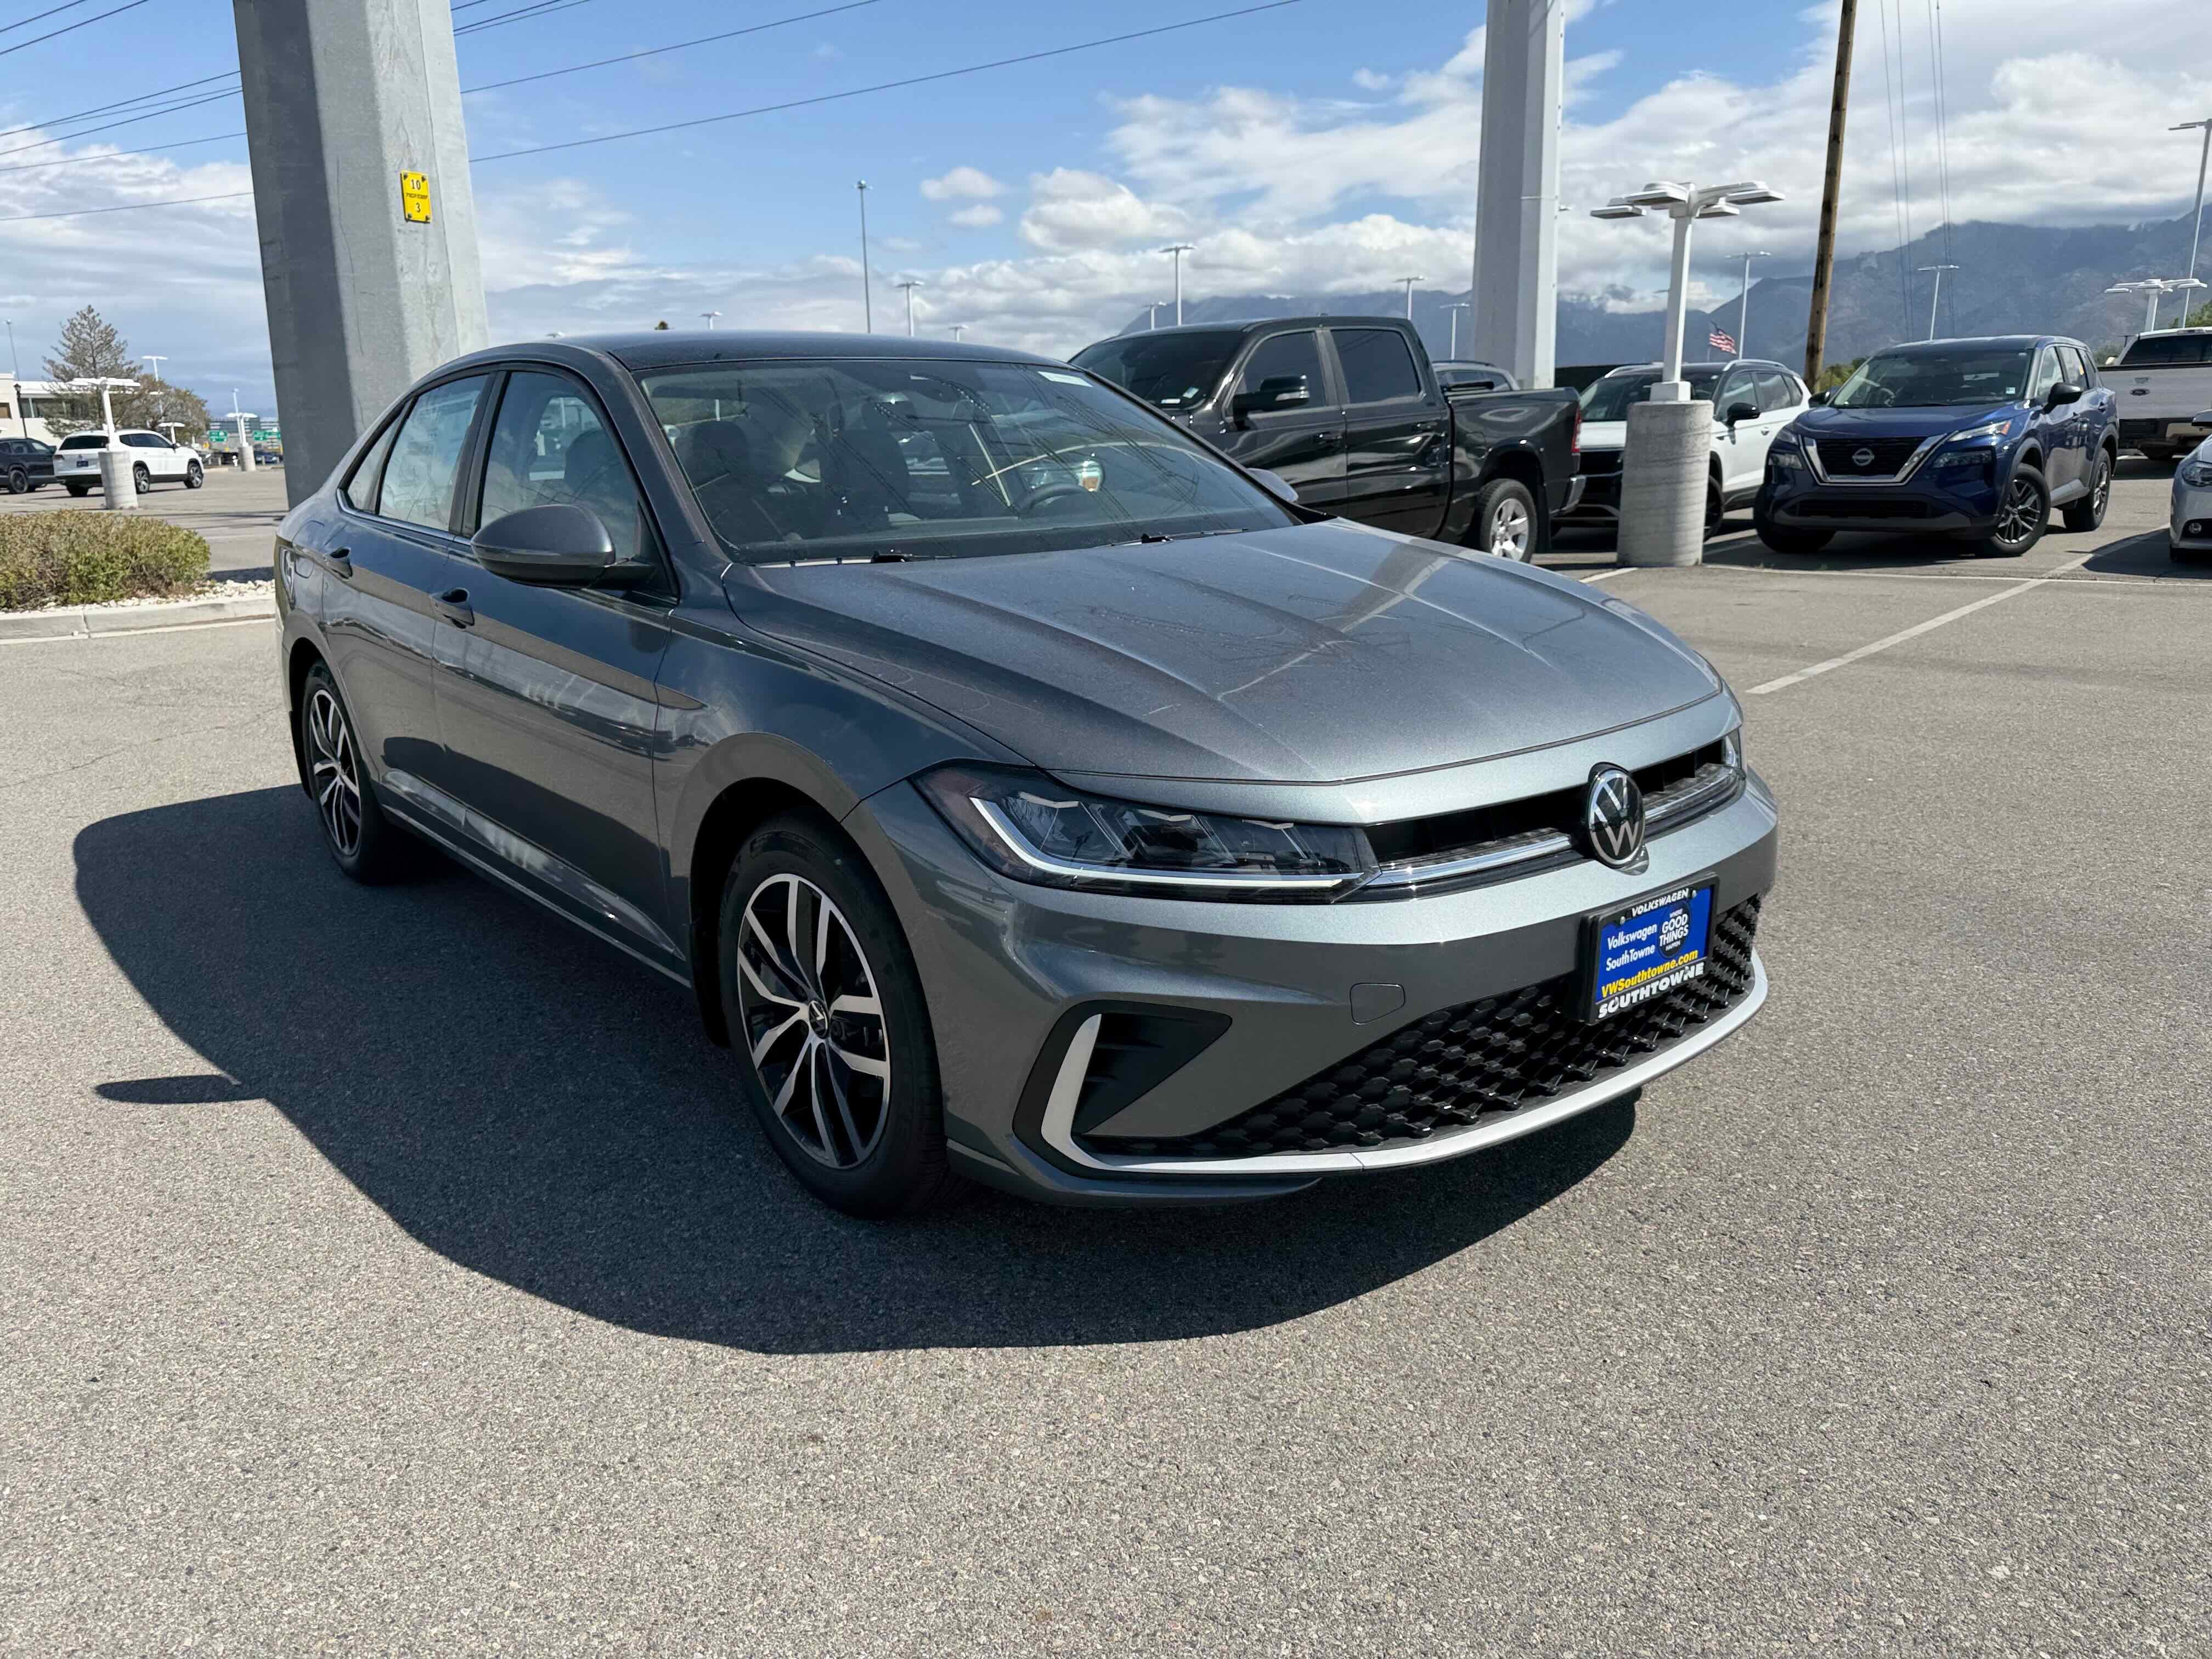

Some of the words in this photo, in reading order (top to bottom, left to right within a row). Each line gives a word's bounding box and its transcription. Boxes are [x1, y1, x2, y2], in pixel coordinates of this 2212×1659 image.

[411, 179, 421, 190] 10
[416, 202, 421, 213] 3
[1632, 888, 1689, 917] VOLKSWAGEN
[1659, 924, 1689, 947] THINGS
[1662, 913, 1688, 933] GOOD
[1607, 924, 1657, 950] Volkswagen
[1606, 944, 1655, 971] SouthTowne
[1601, 950, 1699, 998] VWSouthtowne.com
[1598, 962, 1705, 1019] SOUTHTOWNE
